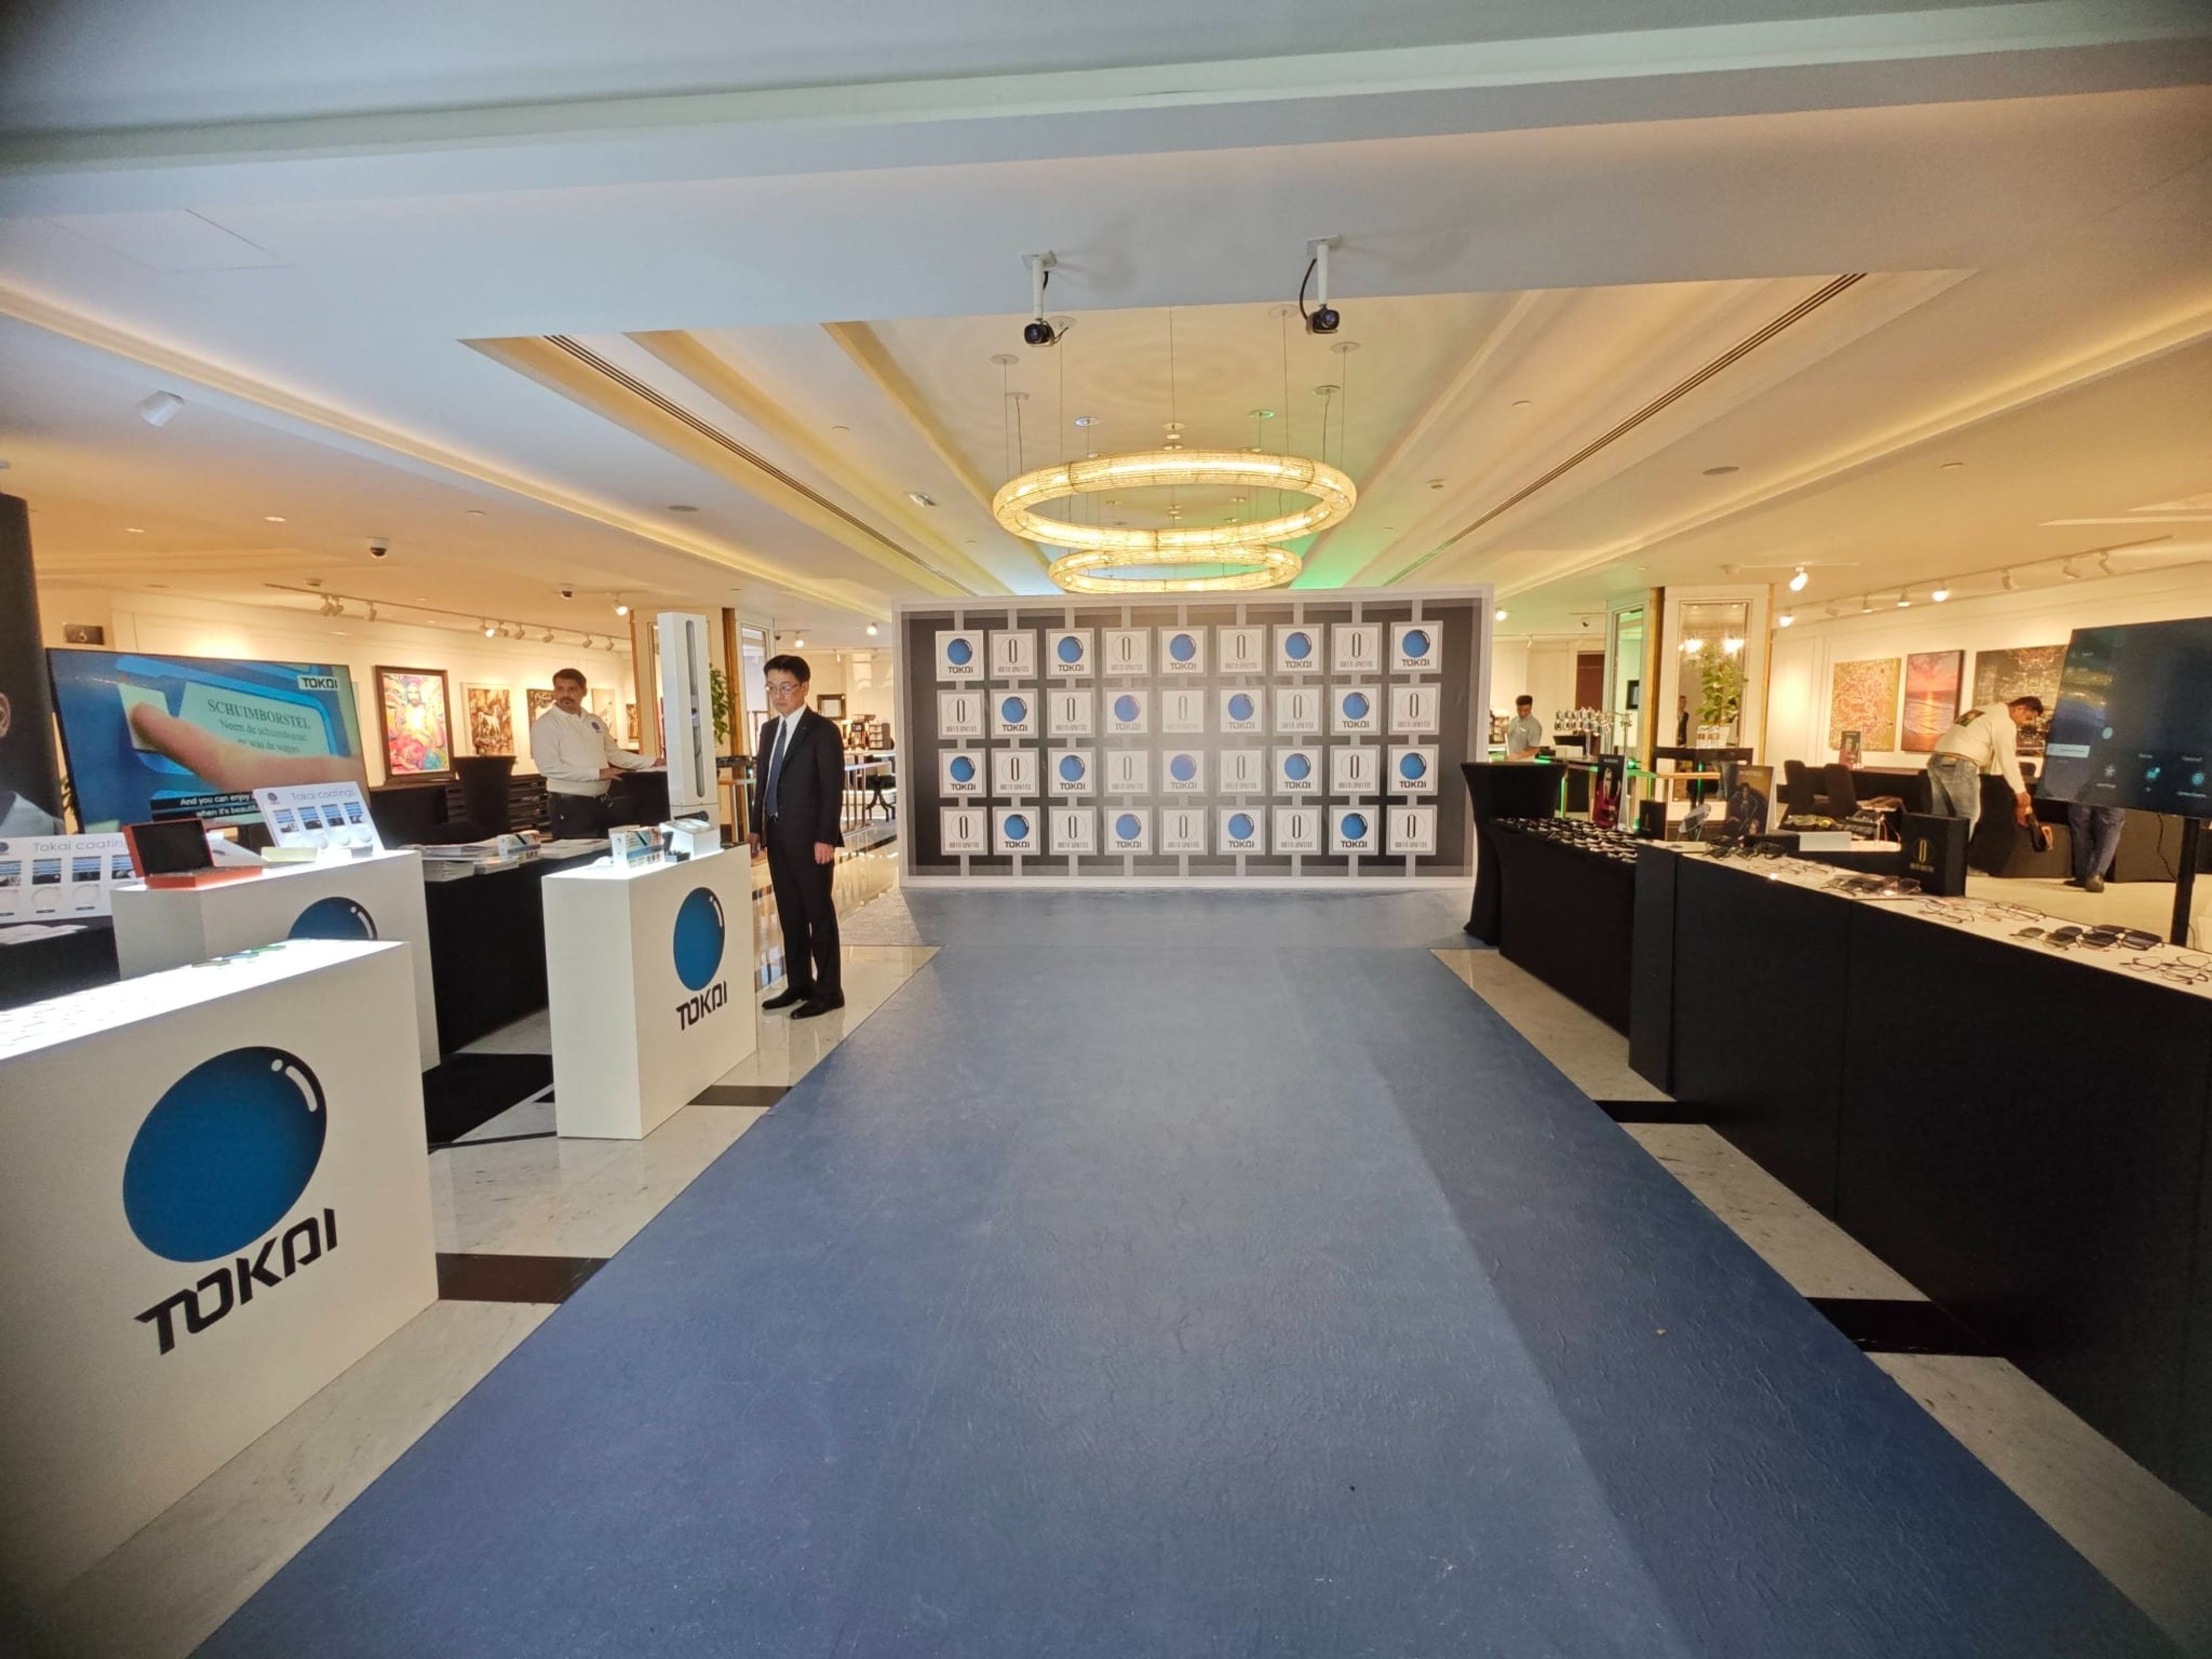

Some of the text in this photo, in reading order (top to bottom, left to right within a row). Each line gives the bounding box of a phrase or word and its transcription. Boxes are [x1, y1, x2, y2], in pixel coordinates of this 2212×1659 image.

[301, 677, 338, 689] TOKAI
[198, 797, 213, 805] you
[196, 809, 218, 817] when
[33, 841, 71, 852] Tokai
[676, 980, 728, 1031] TOKAI
[134, 1207, 338, 1355] TOKAI
